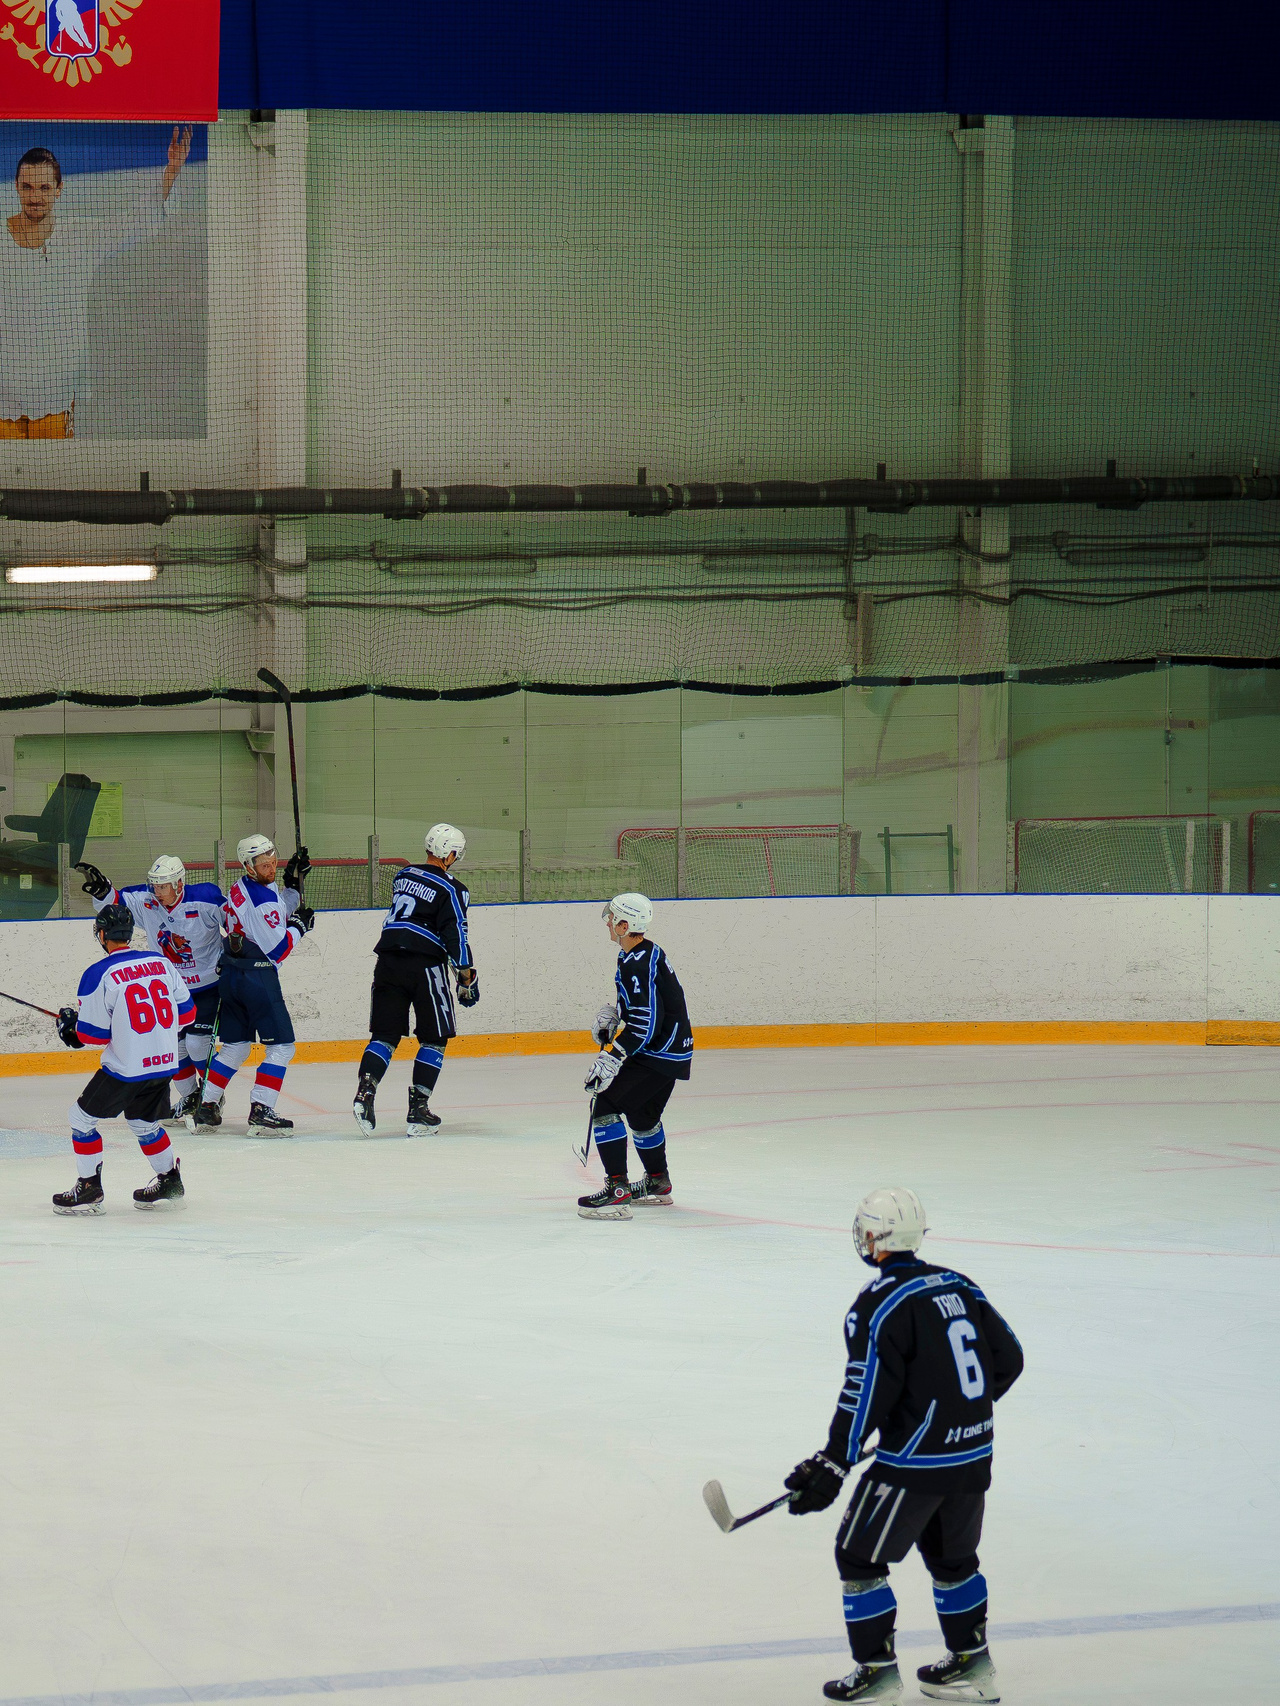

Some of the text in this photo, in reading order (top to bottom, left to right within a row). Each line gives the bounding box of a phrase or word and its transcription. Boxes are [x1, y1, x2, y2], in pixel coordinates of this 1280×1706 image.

[264, 910, 280, 928] 63
[632, 975, 640, 993] 2
[124, 978, 174, 1034] 66
[947, 1318, 985, 1399] 6
